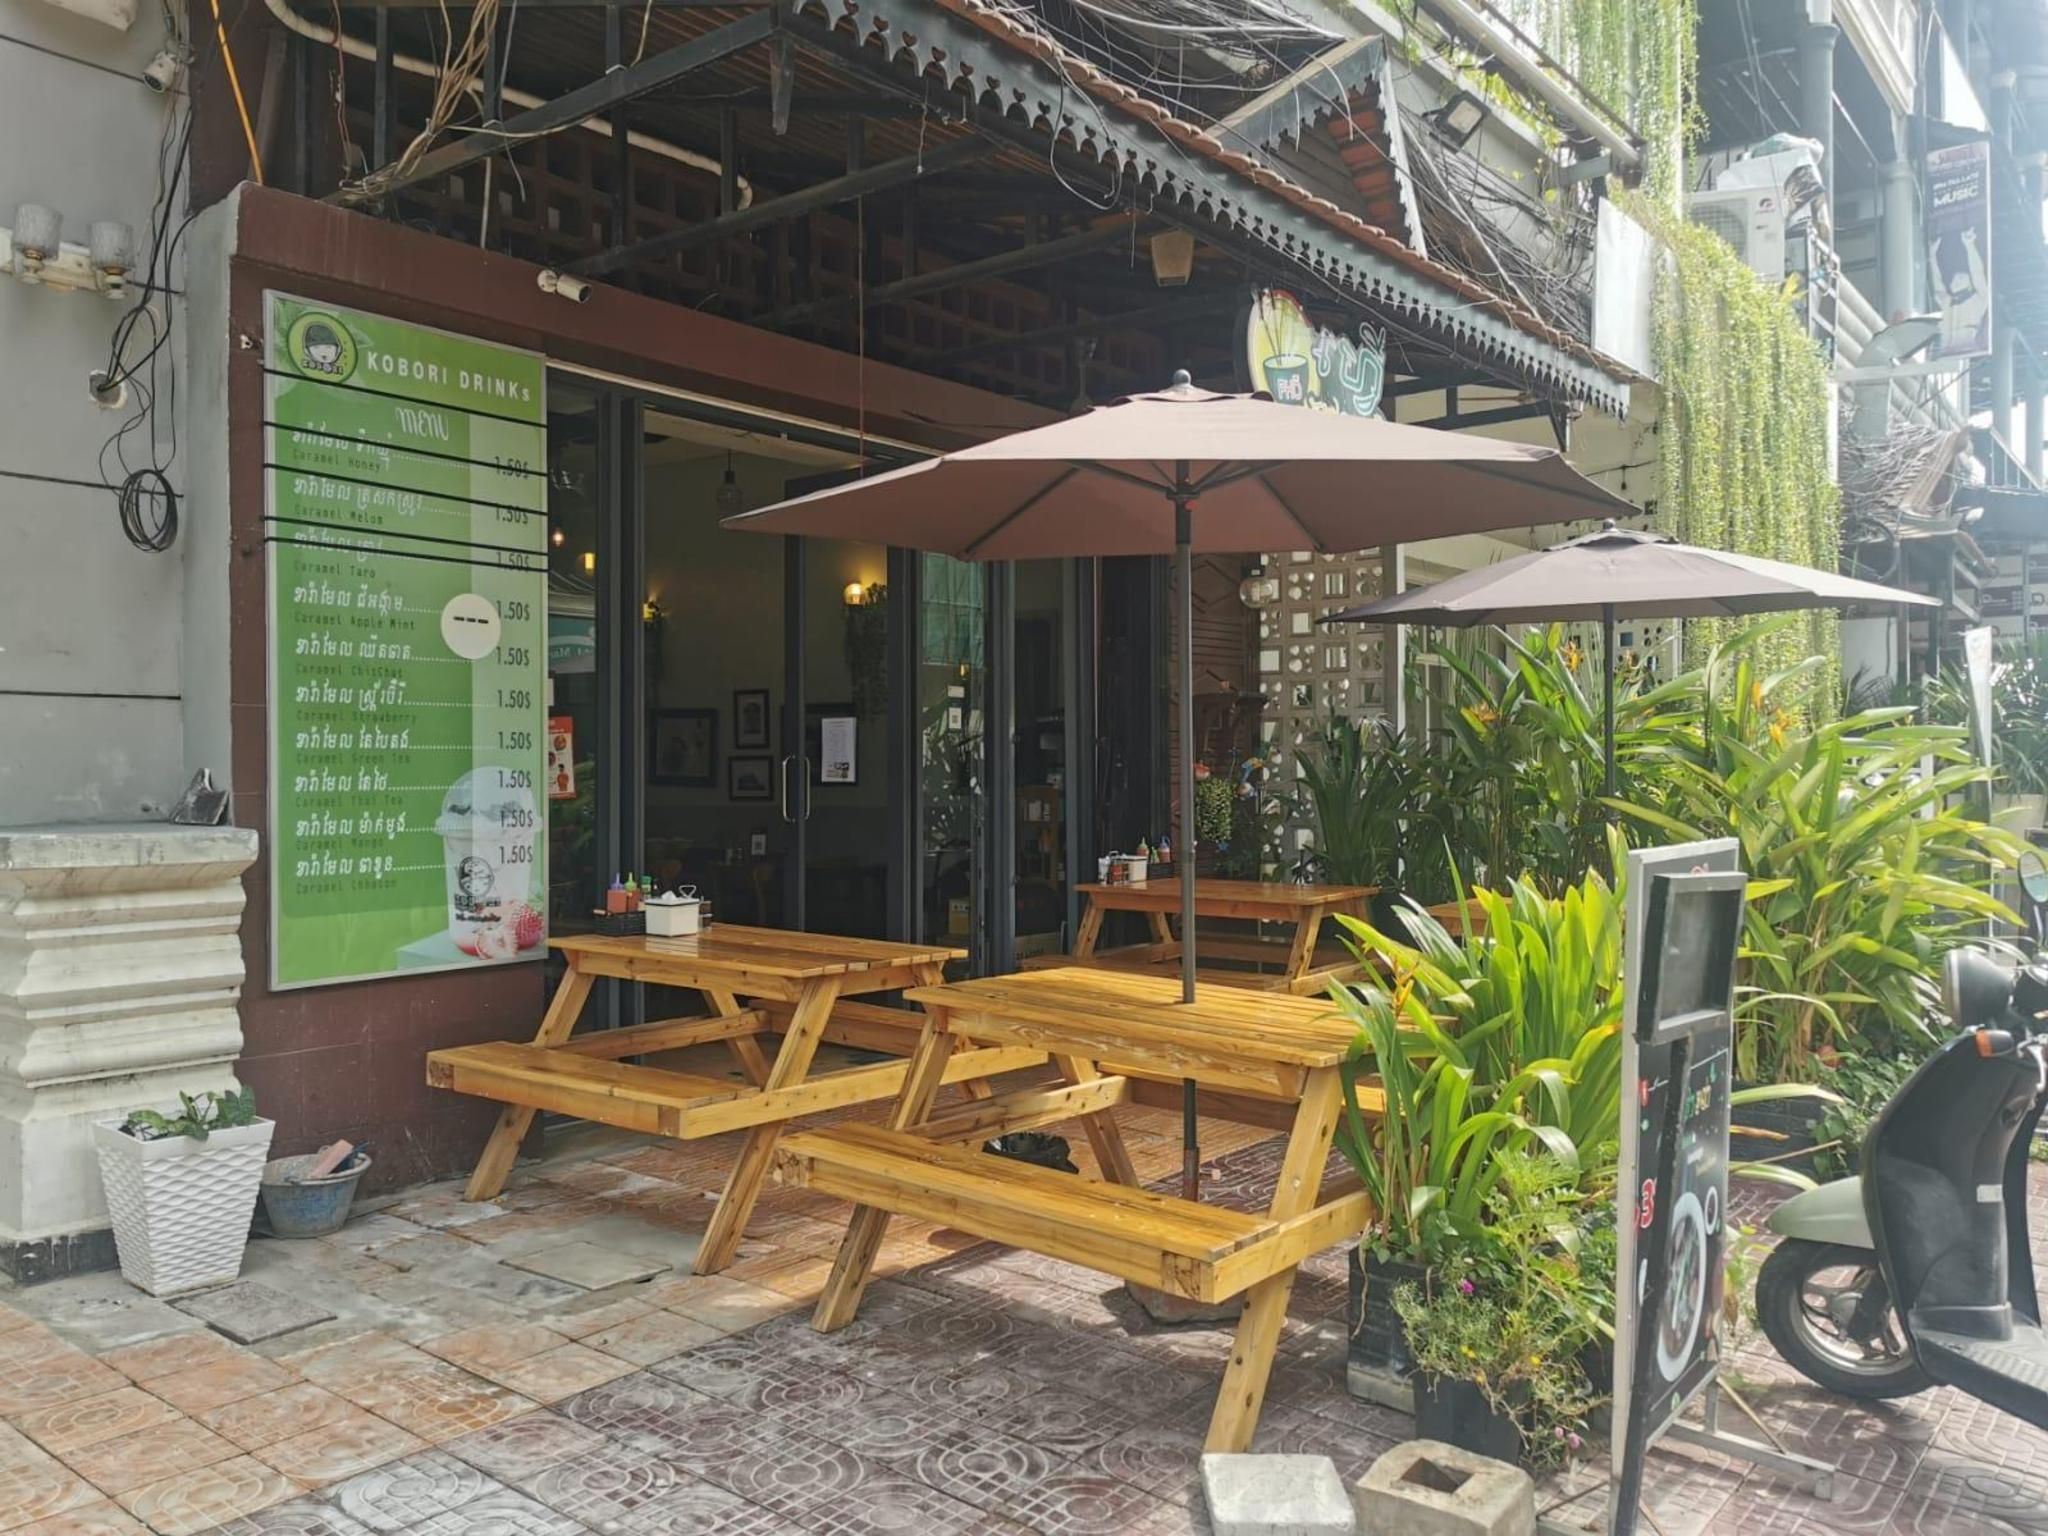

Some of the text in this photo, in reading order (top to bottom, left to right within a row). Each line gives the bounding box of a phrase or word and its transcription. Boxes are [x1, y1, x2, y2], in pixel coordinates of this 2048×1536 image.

[1934, 186, 1978, 208] MUSIC
[368, 351, 447, 385] KOBORI
[350, 565, 376, 578] Taro
[496, 600, 530, 622] 1.50$
[496, 646, 530, 667] 1.50$
[497, 688, 532, 710] 1.50$
[498, 731, 532, 751] 1.50$
[498, 770, 532, 789] 1.50$
[500, 809, 534, 829] 1.50$
[499, 845, 534, 864] 1.50$
